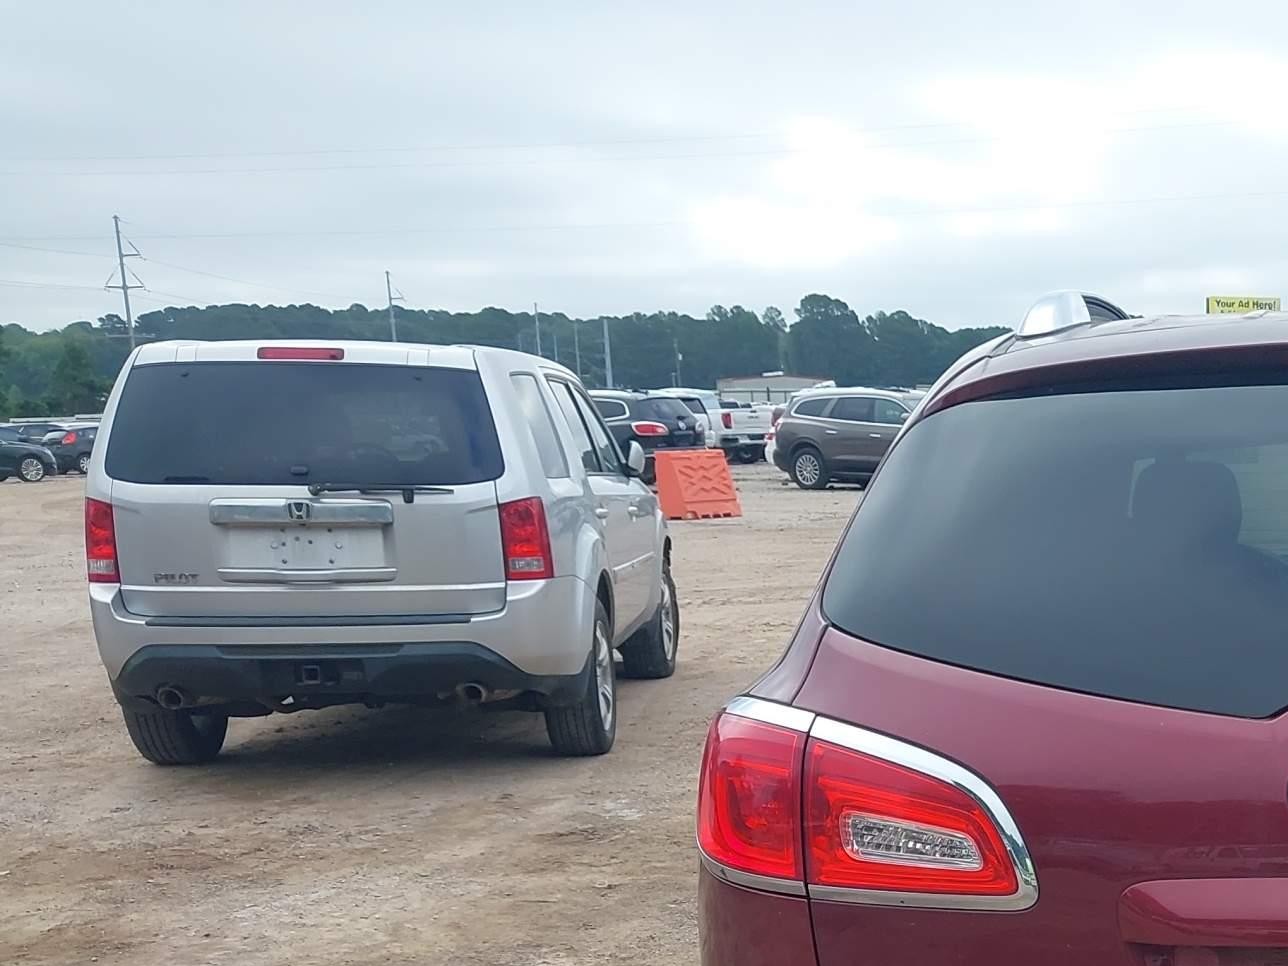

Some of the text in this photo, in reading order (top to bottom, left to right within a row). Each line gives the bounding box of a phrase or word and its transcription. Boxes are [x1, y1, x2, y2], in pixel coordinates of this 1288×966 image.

[1215, 299, 1276, 312] Your Ad Here!
